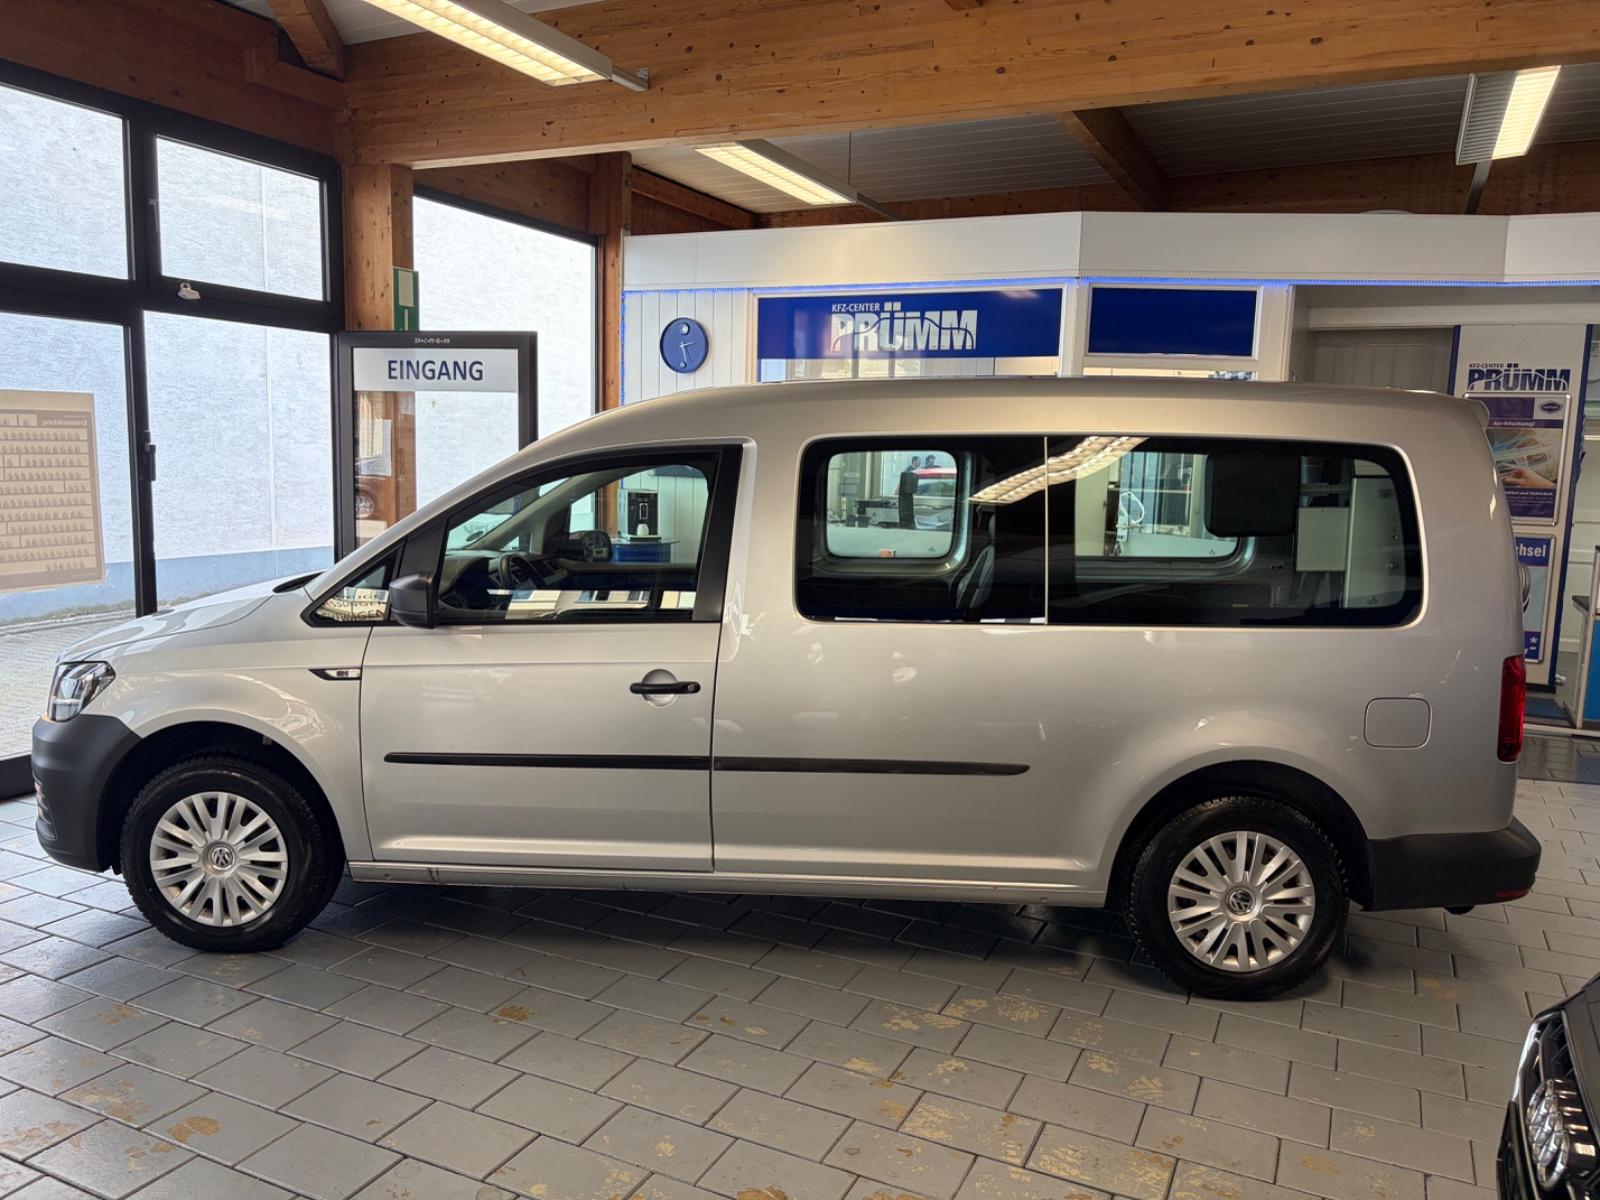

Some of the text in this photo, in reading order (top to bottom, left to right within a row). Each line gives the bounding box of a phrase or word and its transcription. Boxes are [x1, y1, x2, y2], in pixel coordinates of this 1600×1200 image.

[832, 303, 880, 312] KFZ-CENTER
[831, 302, 978, 351] PRÜMM
[388, 360, 484, 381] EINGANG
[1468, 363, 1571, 391] PRÜMM
